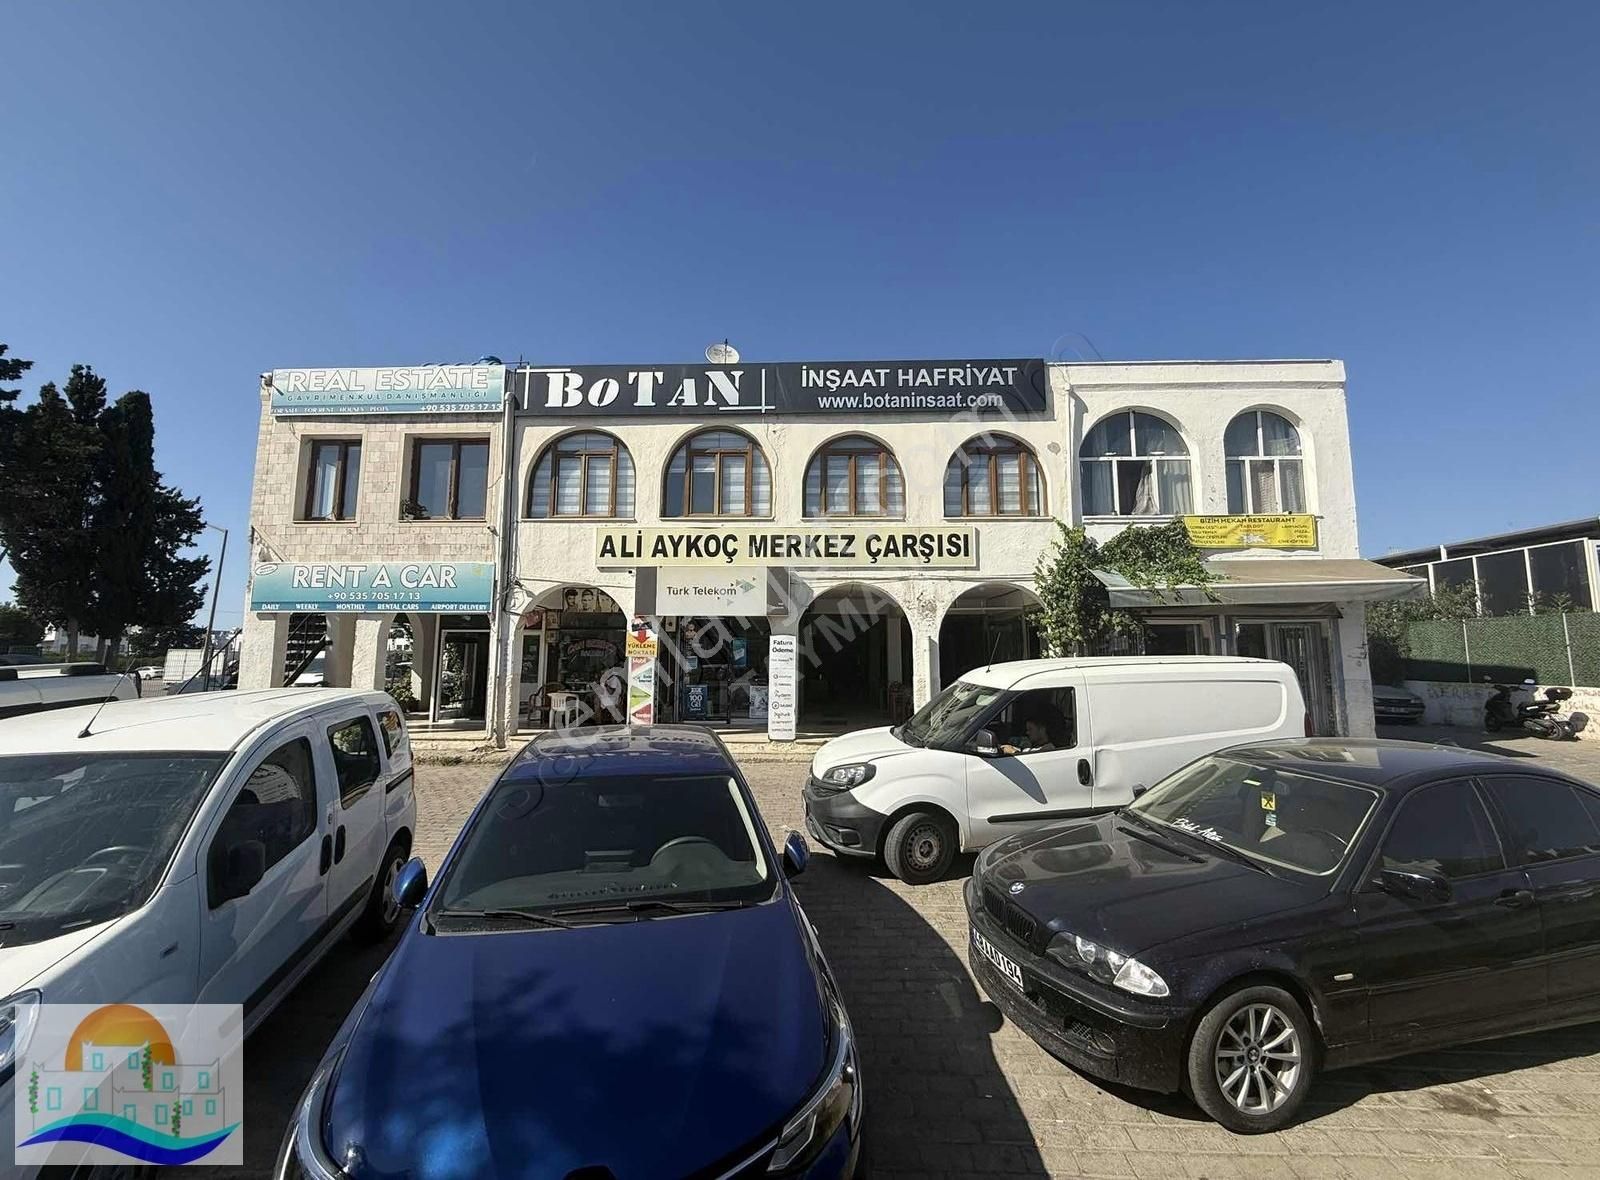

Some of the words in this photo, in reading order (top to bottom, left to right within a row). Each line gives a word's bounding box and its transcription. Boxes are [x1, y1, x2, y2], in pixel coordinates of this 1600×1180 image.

[287, 370, 366, 392] REAL
[375, 368, 489, 391] ESTATE
[801, 365, 890, 392] İNŞAAT
[898, 363, 1018, 388] HAFRİYAT
[818, 392, 1003, 408] www.botaninsaat.com
[600, 530, 642, 558] ALİ
[651, 534, 738, 563] AYKOÇ
[749, 534, 856, 558] MERKEZ
[865, 534, 970, 563] ÇARŞISI
[292, 565, 367, 588] RENT
[371, 565, 392, 588] A
[400, 565, 457, 588] CAR
[327, 592, 347, 600] +90
[349, 592, 368, 600] 535
[371, 592, 390, 600] 705
[394, 592, 404, 600] 17
[409, 592, 421, 600] 13
[667, 587, 690, 596] Türk
[693, 587, 737, 596] Telekom
